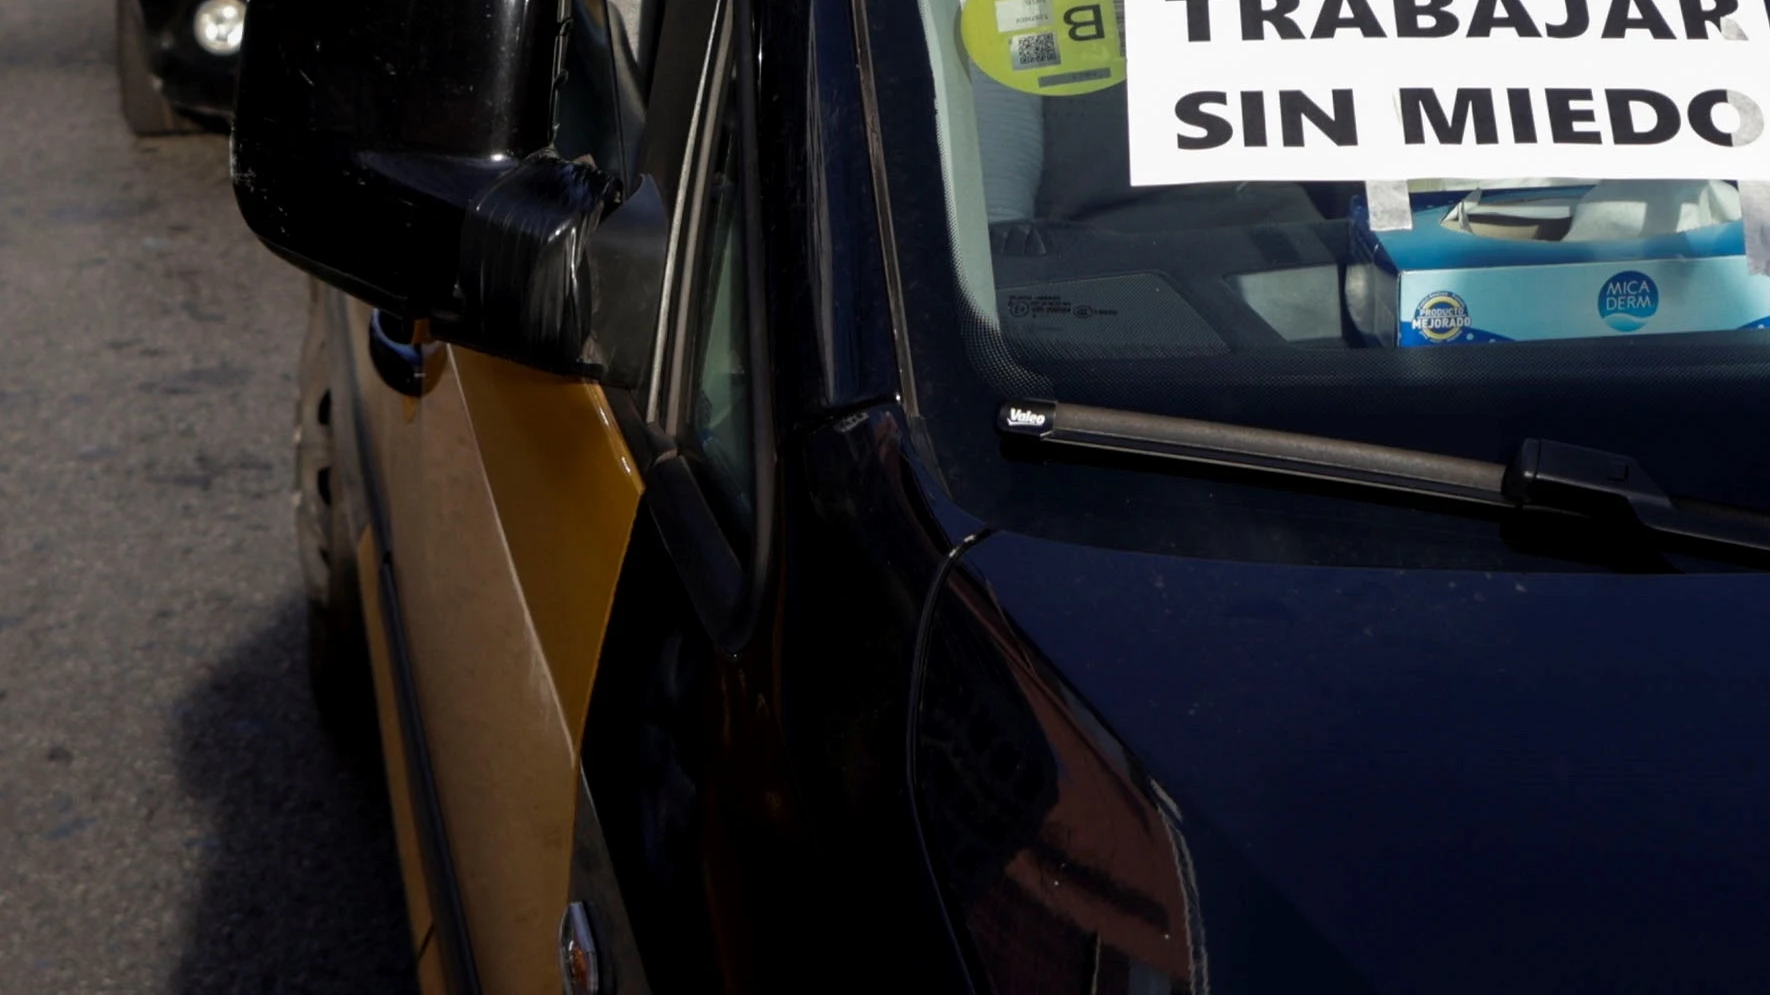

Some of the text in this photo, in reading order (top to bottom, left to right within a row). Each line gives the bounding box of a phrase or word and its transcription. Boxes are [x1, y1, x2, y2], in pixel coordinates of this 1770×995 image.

[1063, 4, 1105, 42] B
[1175, 88, 1765, 150] SIN MIEDO
[1606, 279, 1650, 295] MICA
[1606, 295, 1652, 311] DERM
[1419, 307, 1465, 317] PRODUCTO
[1411, 317, 1472, 330] MEJORADO
[1010, 407, 1046, 425] Valeo
